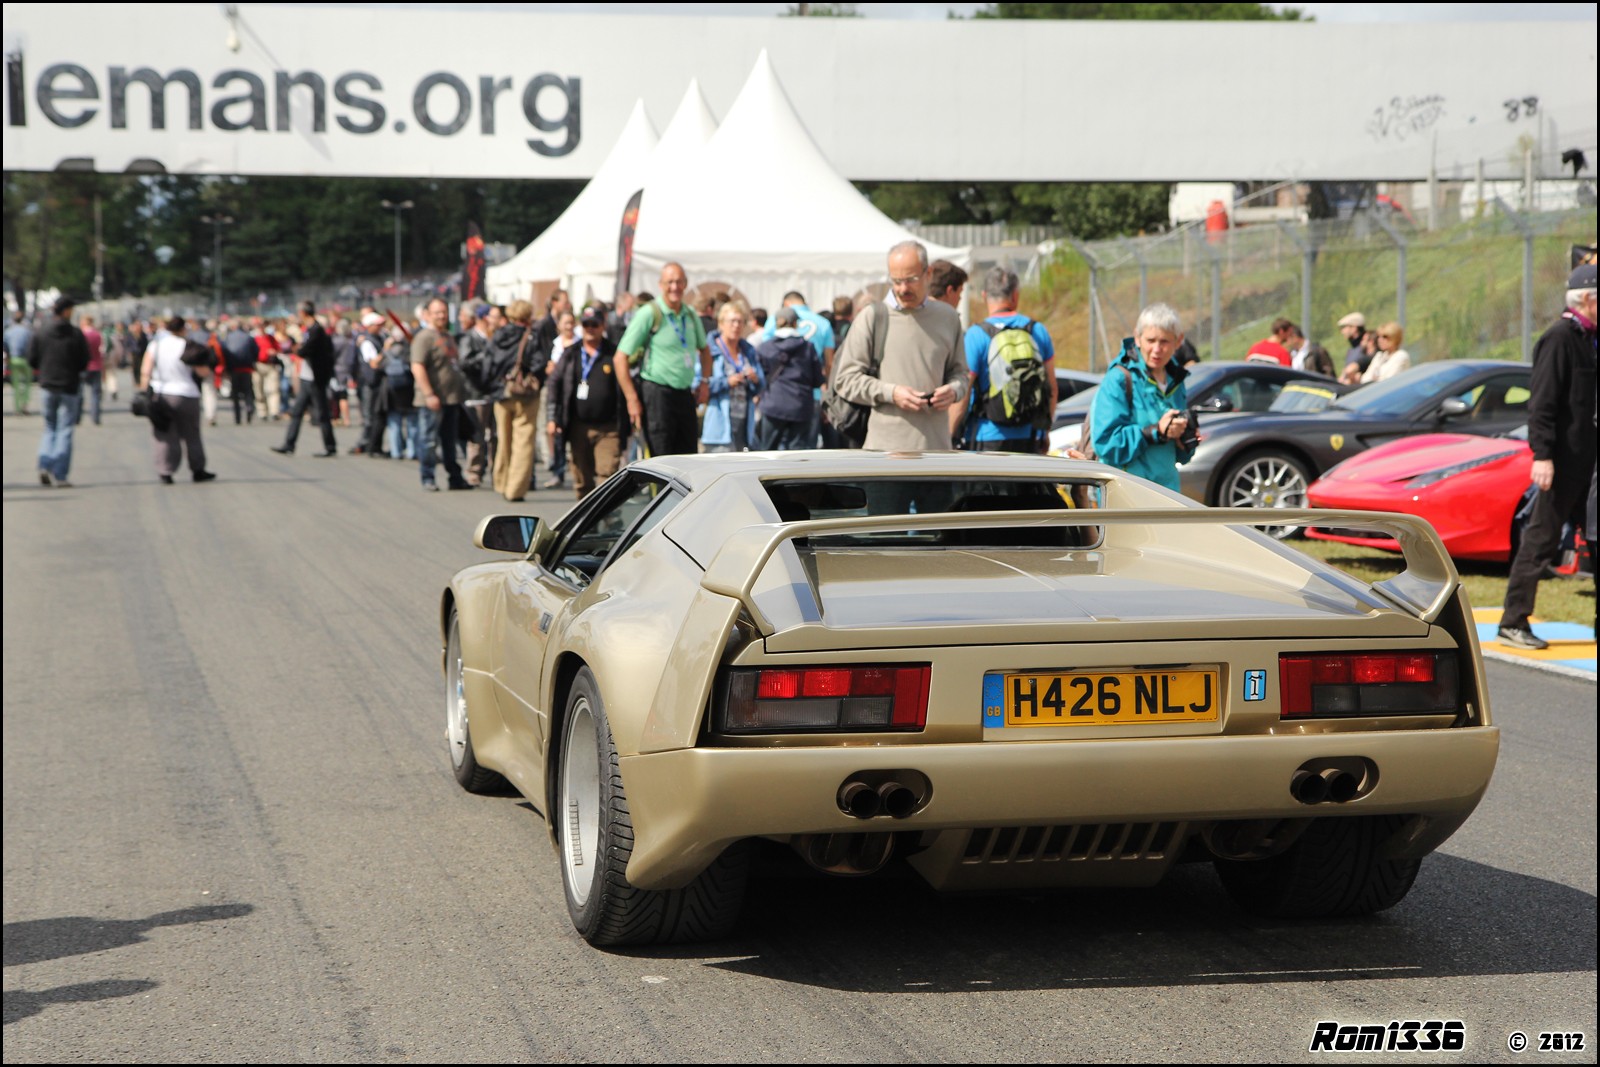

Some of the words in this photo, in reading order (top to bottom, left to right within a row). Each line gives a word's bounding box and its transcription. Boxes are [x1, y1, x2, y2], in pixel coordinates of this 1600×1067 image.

[1013, 676, 1121, 718] H426
[1134, 673, 1212, 715] NLJ
[986, 706, 1001, 717] GB
